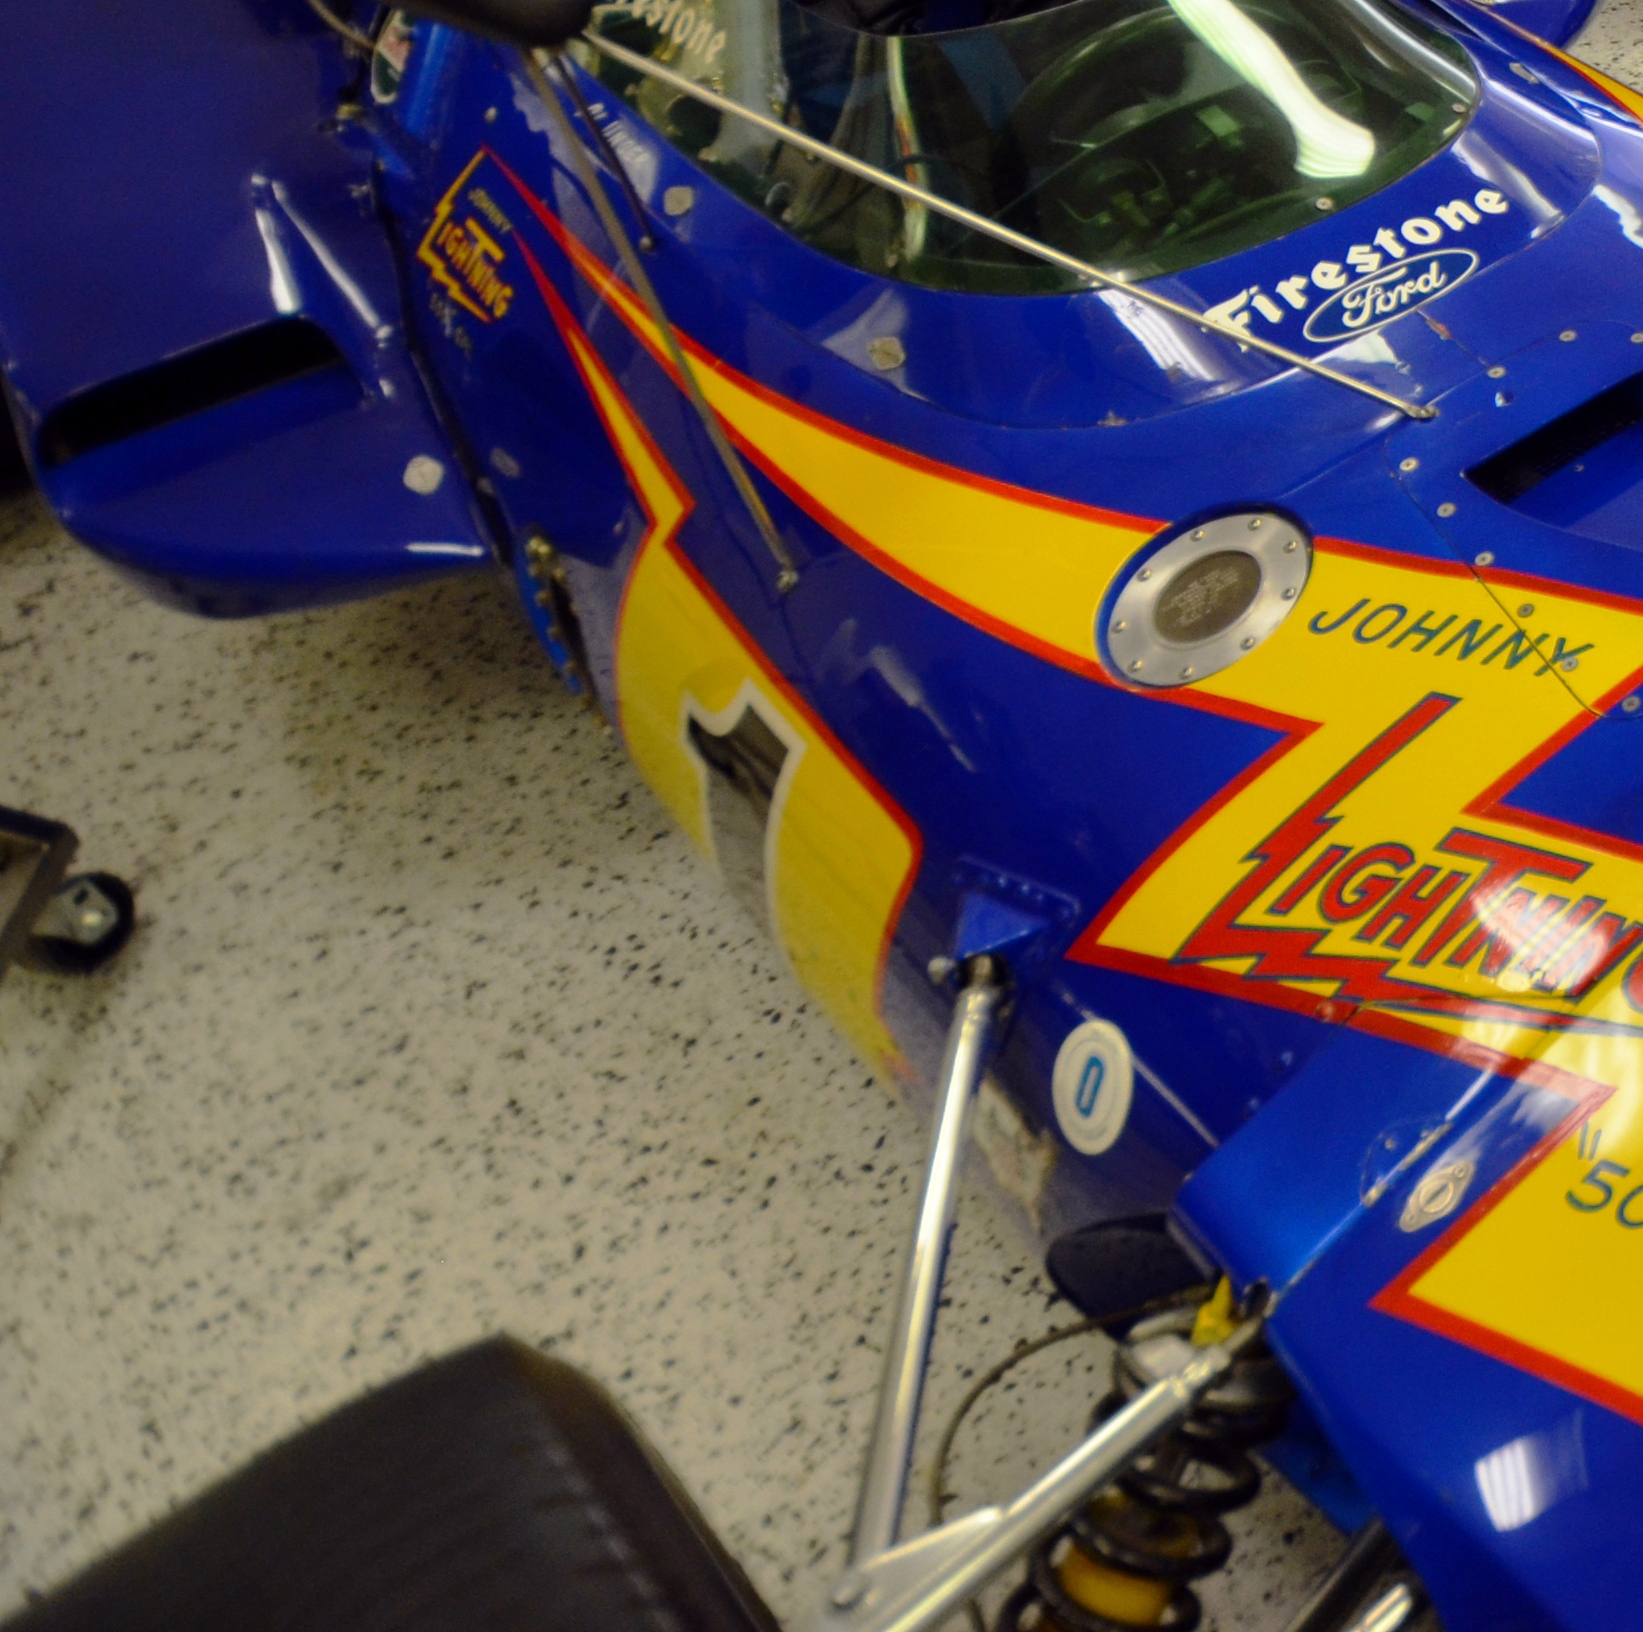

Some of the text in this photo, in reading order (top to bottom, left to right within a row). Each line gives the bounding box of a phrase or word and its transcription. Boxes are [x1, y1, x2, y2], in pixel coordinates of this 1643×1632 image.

[1202, 187, 1510, 353] Firestone
[1341, 261, 1447, 329] Ford
[1308, 597, 1596, 682] JOHNNY
